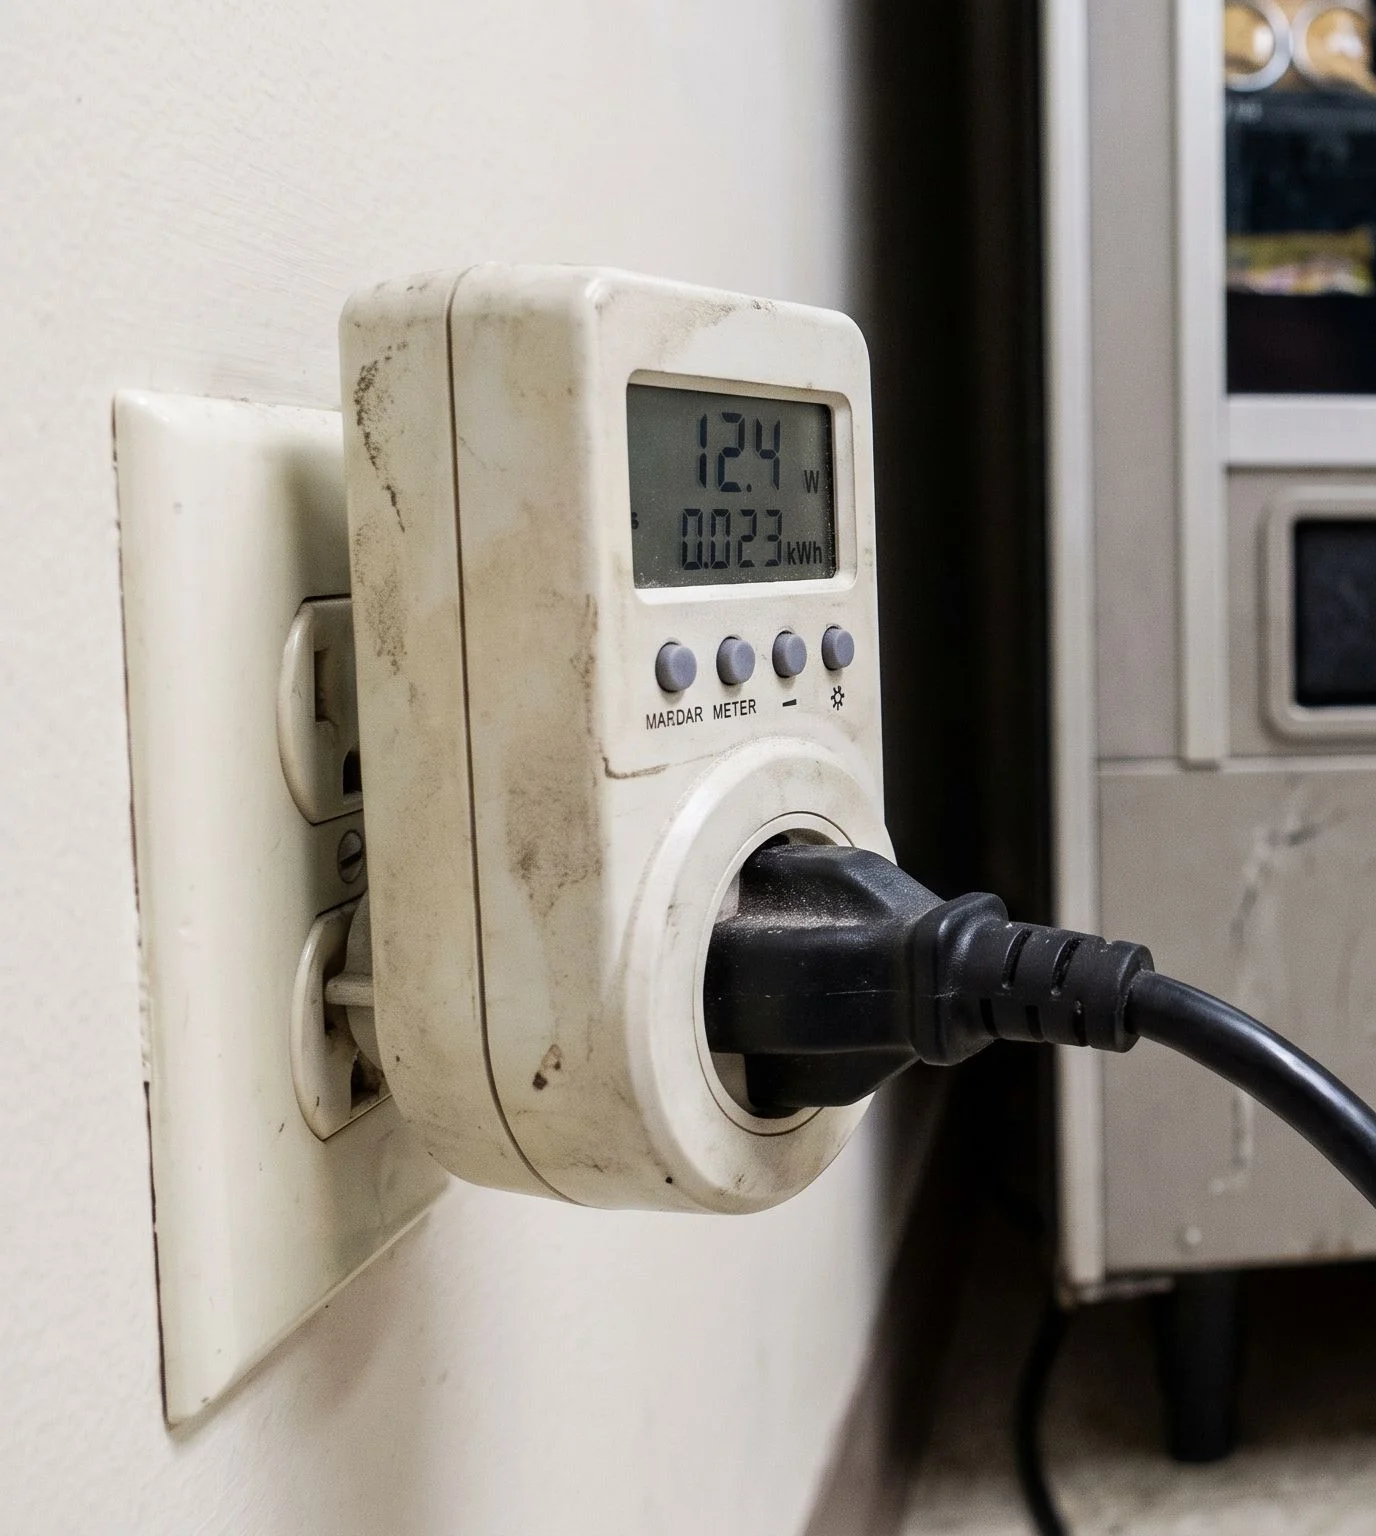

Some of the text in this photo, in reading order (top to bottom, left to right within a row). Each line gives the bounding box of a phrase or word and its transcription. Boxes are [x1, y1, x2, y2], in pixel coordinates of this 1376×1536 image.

[697, 411, 820, 494] 12.4 W
[681, 508, 823, 571] 0.023 kWh
[646, 698, 757, 730] MARDAR METER
